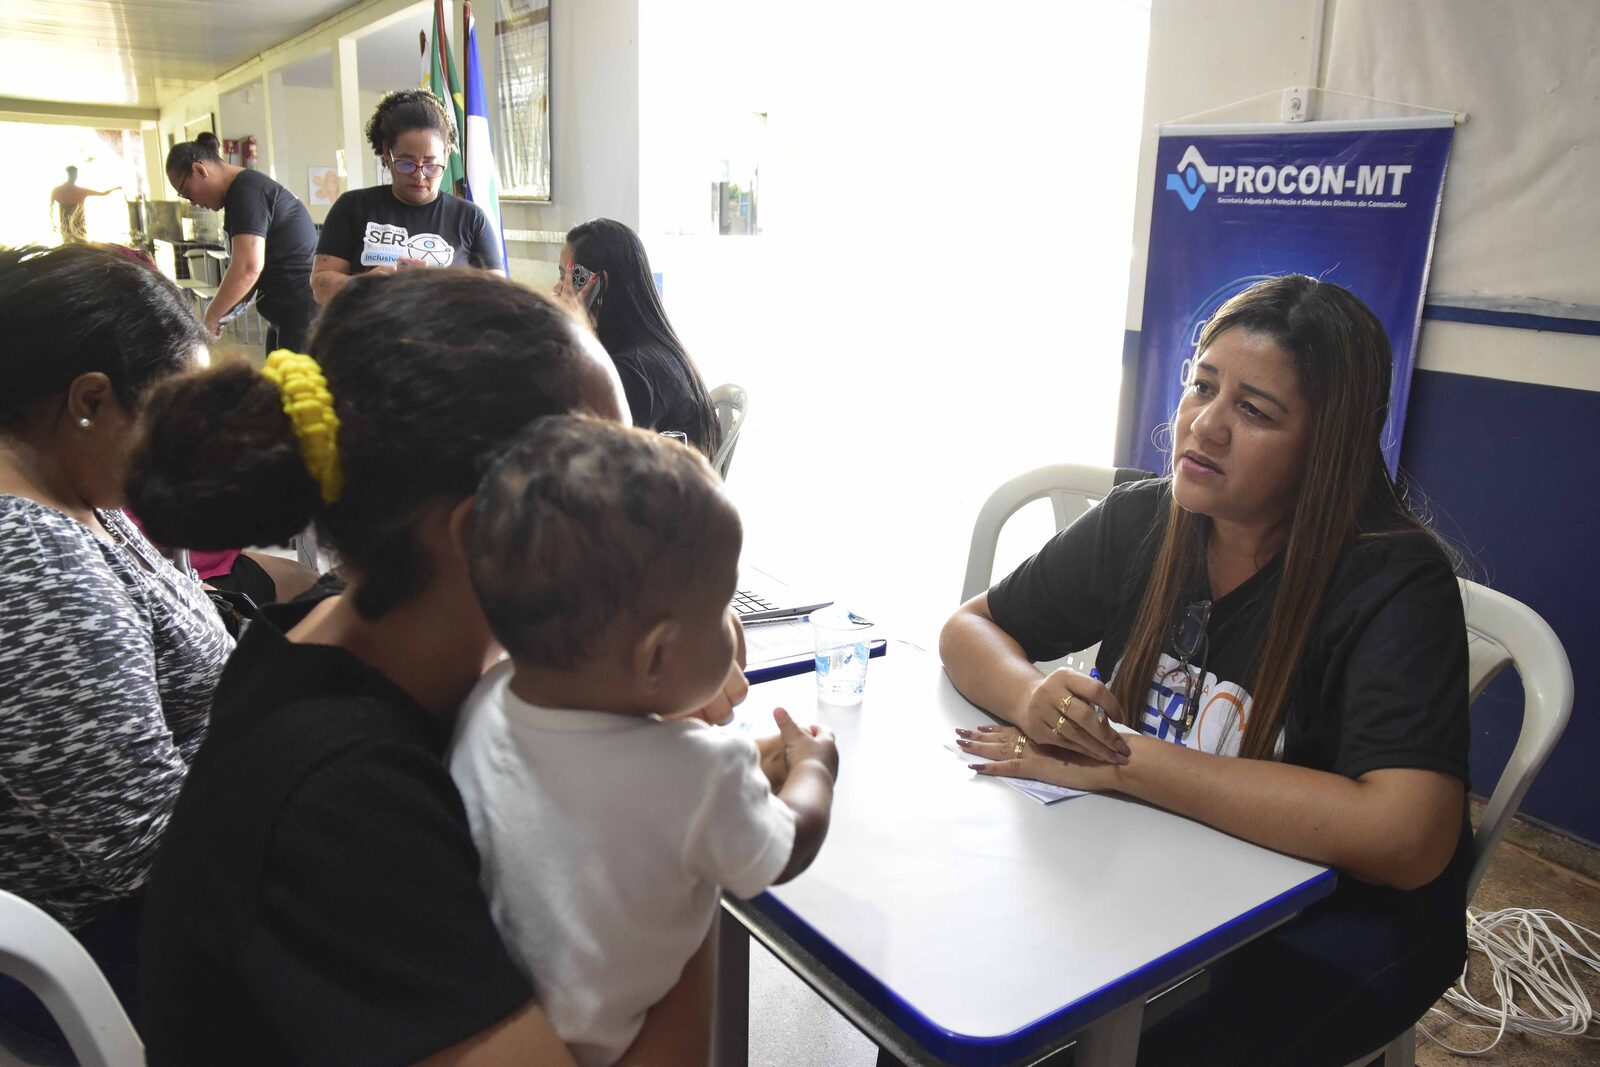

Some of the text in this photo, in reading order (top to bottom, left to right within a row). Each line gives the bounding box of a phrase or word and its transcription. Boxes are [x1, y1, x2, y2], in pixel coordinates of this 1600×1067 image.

[1217, 165, 1412, 195] PROCON-MT
[1244, 197, 1264, 205] Adjunta
[1273, 198, 1296, 206] Proteção
[368, 230, 405, 247] SER
